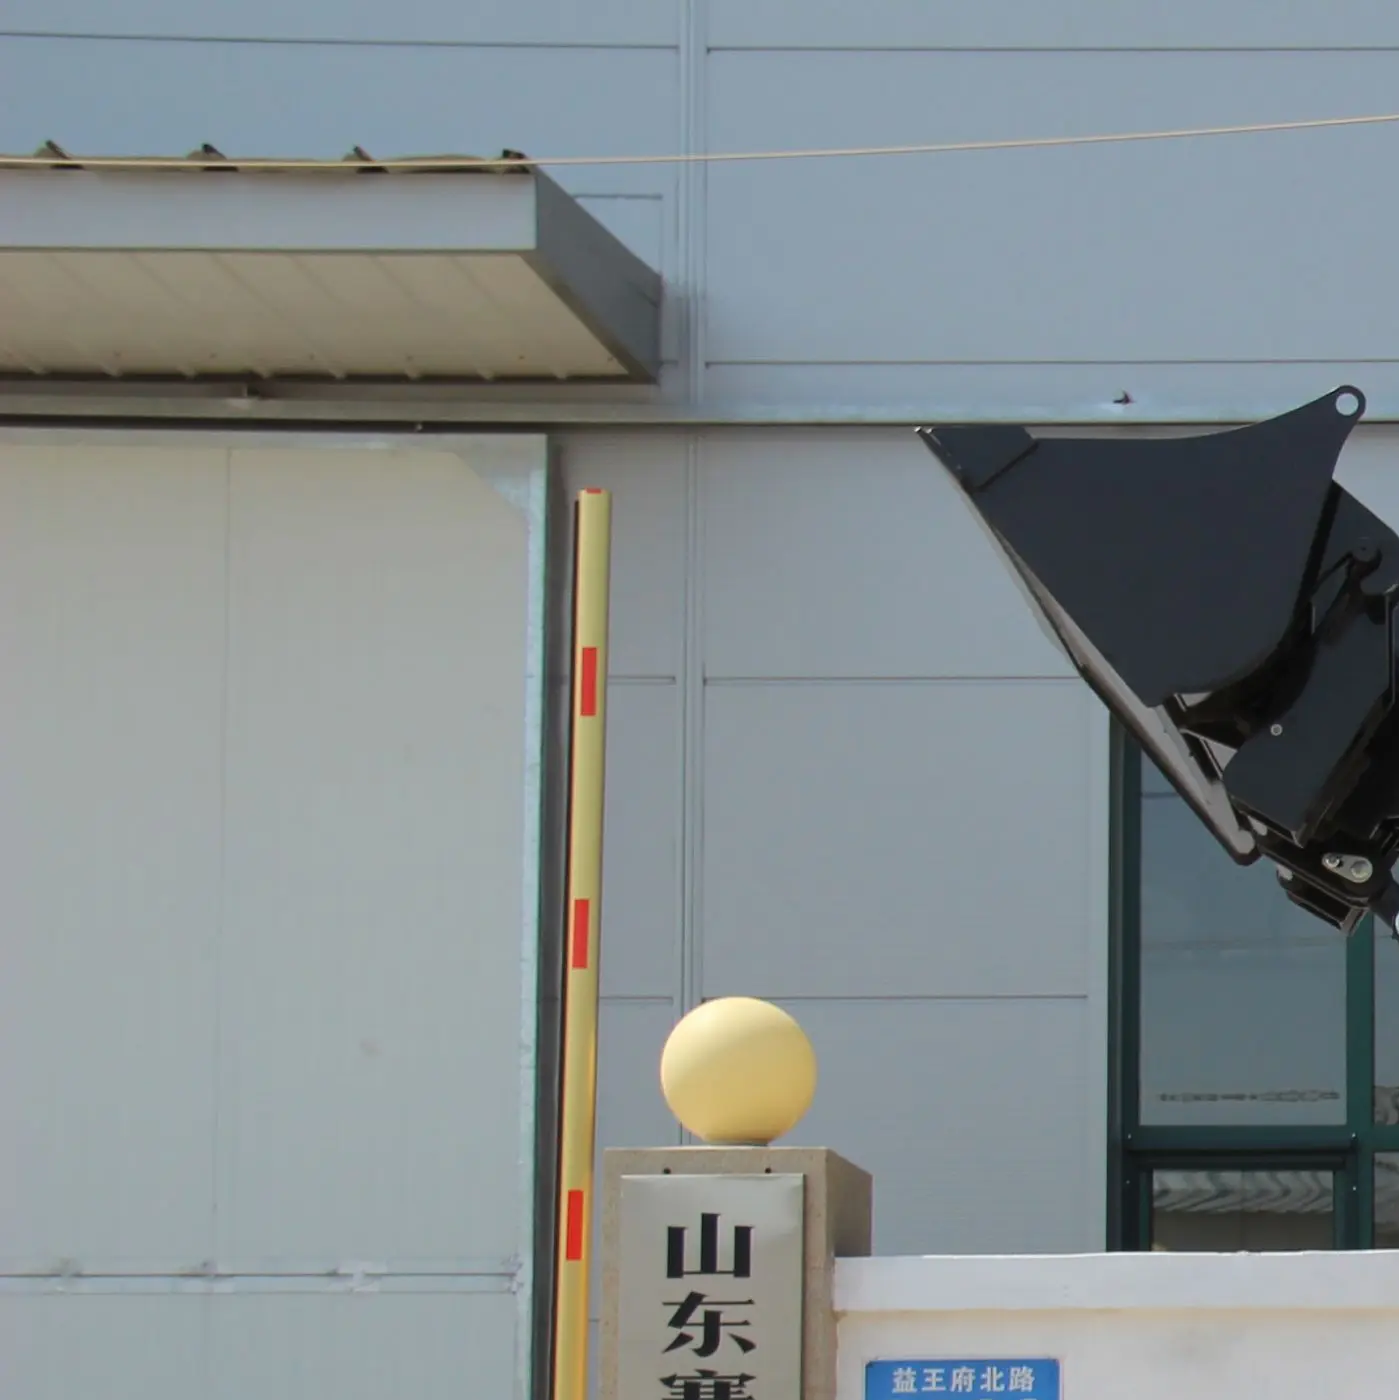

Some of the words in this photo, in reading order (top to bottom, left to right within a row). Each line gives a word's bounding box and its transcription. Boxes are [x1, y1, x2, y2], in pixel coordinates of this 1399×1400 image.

[891, 1365, 1036, 1393] 益王府北路
